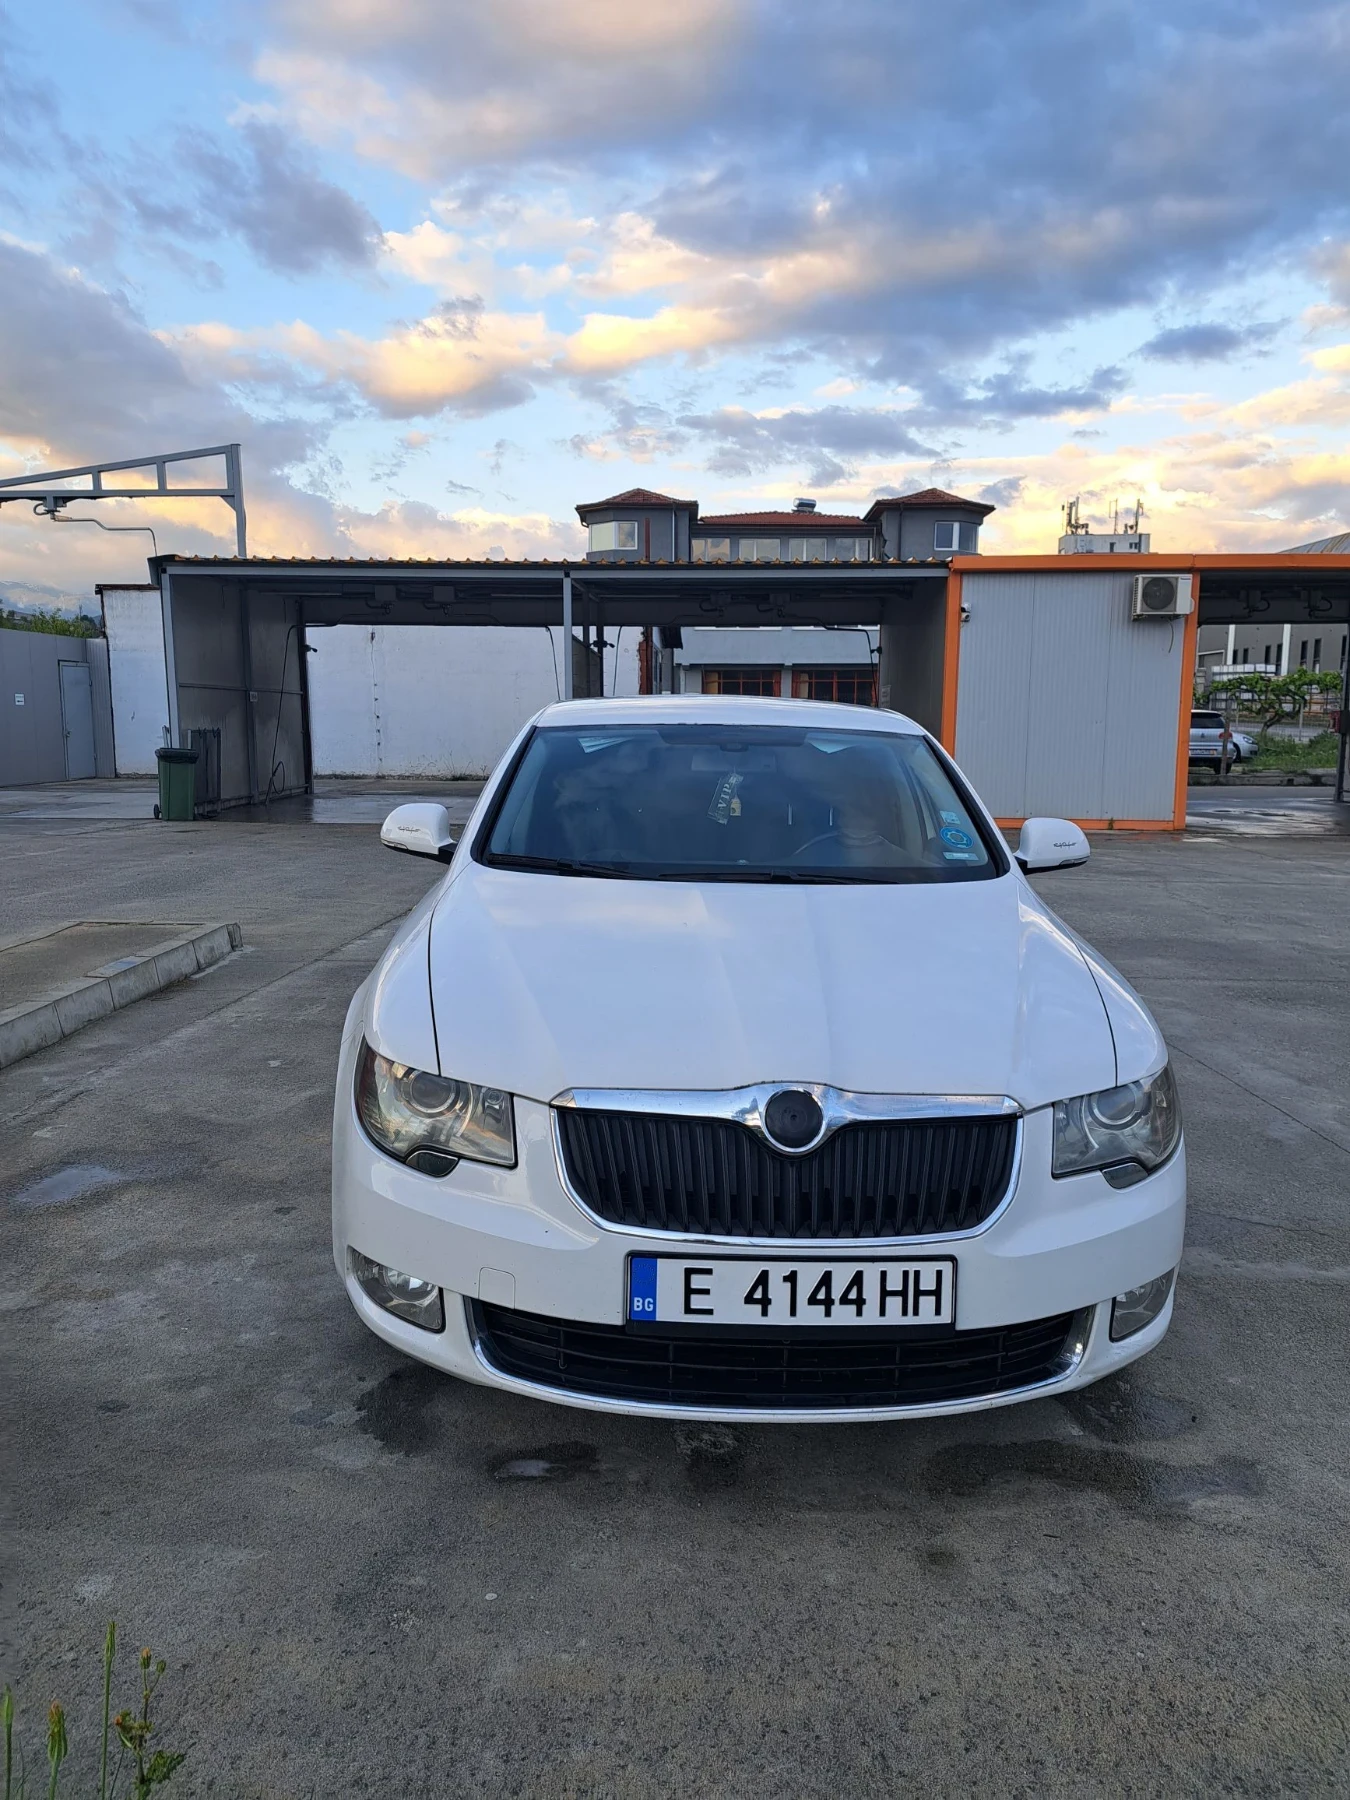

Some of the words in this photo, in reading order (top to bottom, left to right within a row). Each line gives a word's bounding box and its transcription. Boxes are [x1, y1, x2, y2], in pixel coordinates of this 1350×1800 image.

[717, 783, 732, 808] VIP
[683, 1267, 714, 1316] E
[633, 1297, 654, 1312] BG
